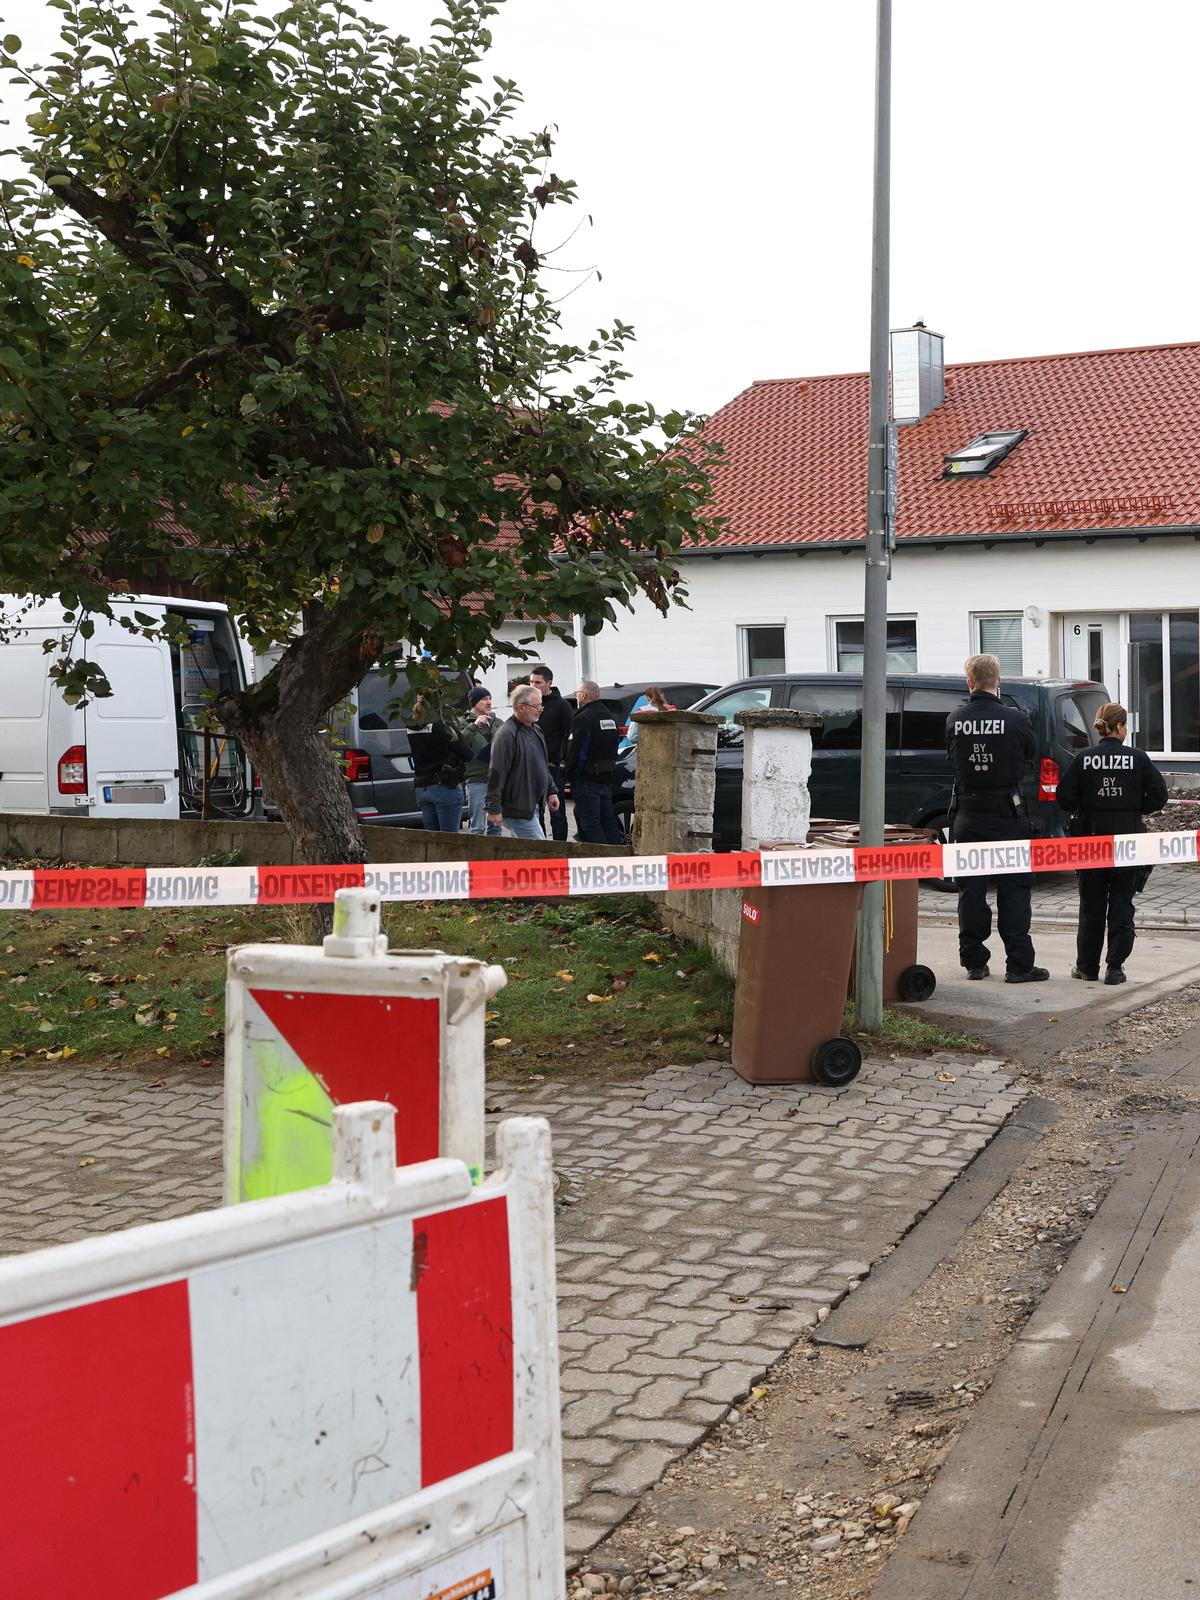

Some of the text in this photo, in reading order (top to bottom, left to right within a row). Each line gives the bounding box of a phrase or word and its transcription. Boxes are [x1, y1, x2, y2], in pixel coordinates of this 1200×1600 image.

[1074, 624, 1081, 636] 6
[954, 720, 1005, 736] POLIZEI
[973, 744, 986, 754] BY
[968, 753, 994, 763] 4131
[1083, 755, 1134, 770] POLIZEI
[1103, 777, 1116, 787] BY
[1097, 787, 1123, 797] 4131
[743, 903, 757, 920] SULO
